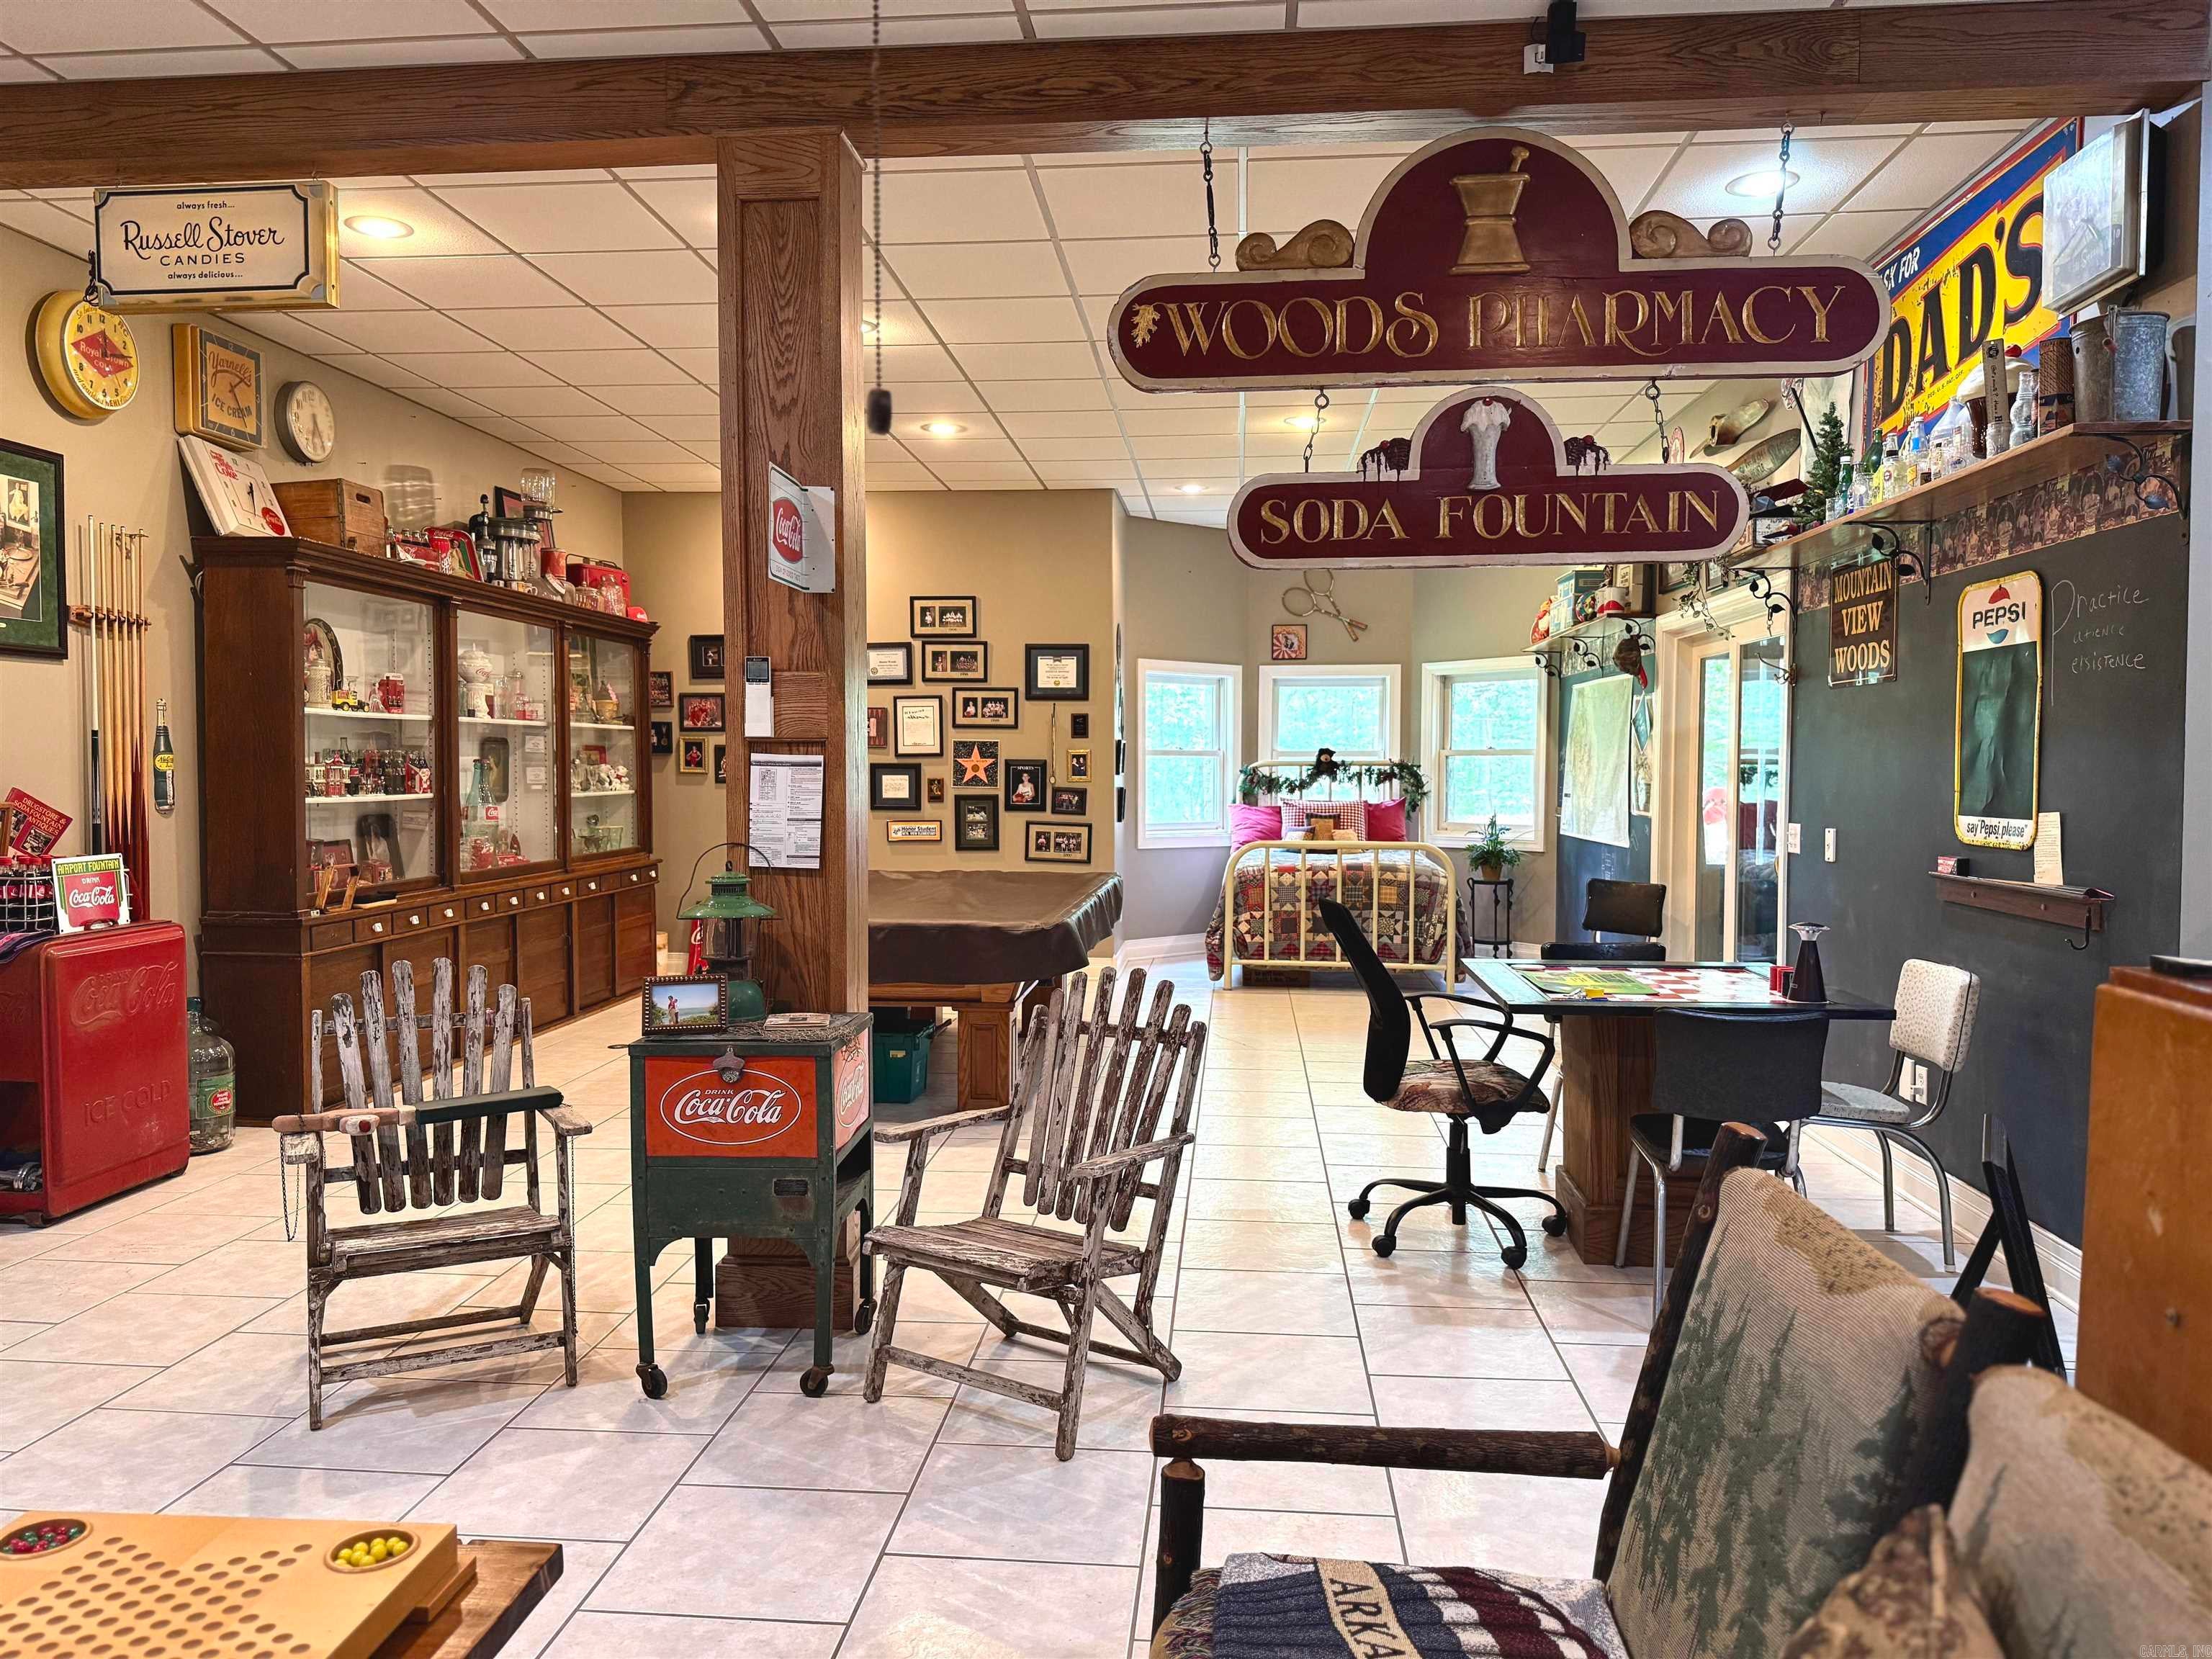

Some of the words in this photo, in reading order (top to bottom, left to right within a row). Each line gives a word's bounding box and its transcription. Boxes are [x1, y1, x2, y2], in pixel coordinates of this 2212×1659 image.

[176, 201, 205, 210] always
[207, 200, 235, 209] fresh...
[120, 220, 204, 260] Russell
[206, 216, 284, 252] Stover
[160, 252, 245, 266] CANDIES
[1898, 246, 1920, 284] FOR
[167, 271, 197, 279] always
[198, 270, 243, 279] delicious...
[1154, 291, 1439, 360] WOODS
[1466, 284, 1846, 356] PHARMACY
[80, 341, 102, 358] Royal
[212, 394, 225, 413] ICE
[1260, 498, 1409, 545] SODA
[1435, 490, 1719, 540] FOUNTAIN
[1834, 560, 1892, 603] MOUNTAIN
[1841, 601, 1884, 637] VIEW
[1972, 601, 2026, 630] PEPSI
[1834, 639, 1890, 674] WOODS
[13, 800, 30, 813] SODA
[30, 809, 64, 830] FOUNTAIN
[22, 797, 60, 821] DRUGSTORE
[27, 815, 60, 835] ANTIQUES
[1966, 822, 1979, 837] say
[58, 862, 86, 875] AIRPORT
[88, 859, 120, 871] FOUNTAIN
[84, 1095, 115, 1126] ICE
[122, 1080, 171, 1110] COLD
[674, 1089, 787, 1125] Coca-Cola
